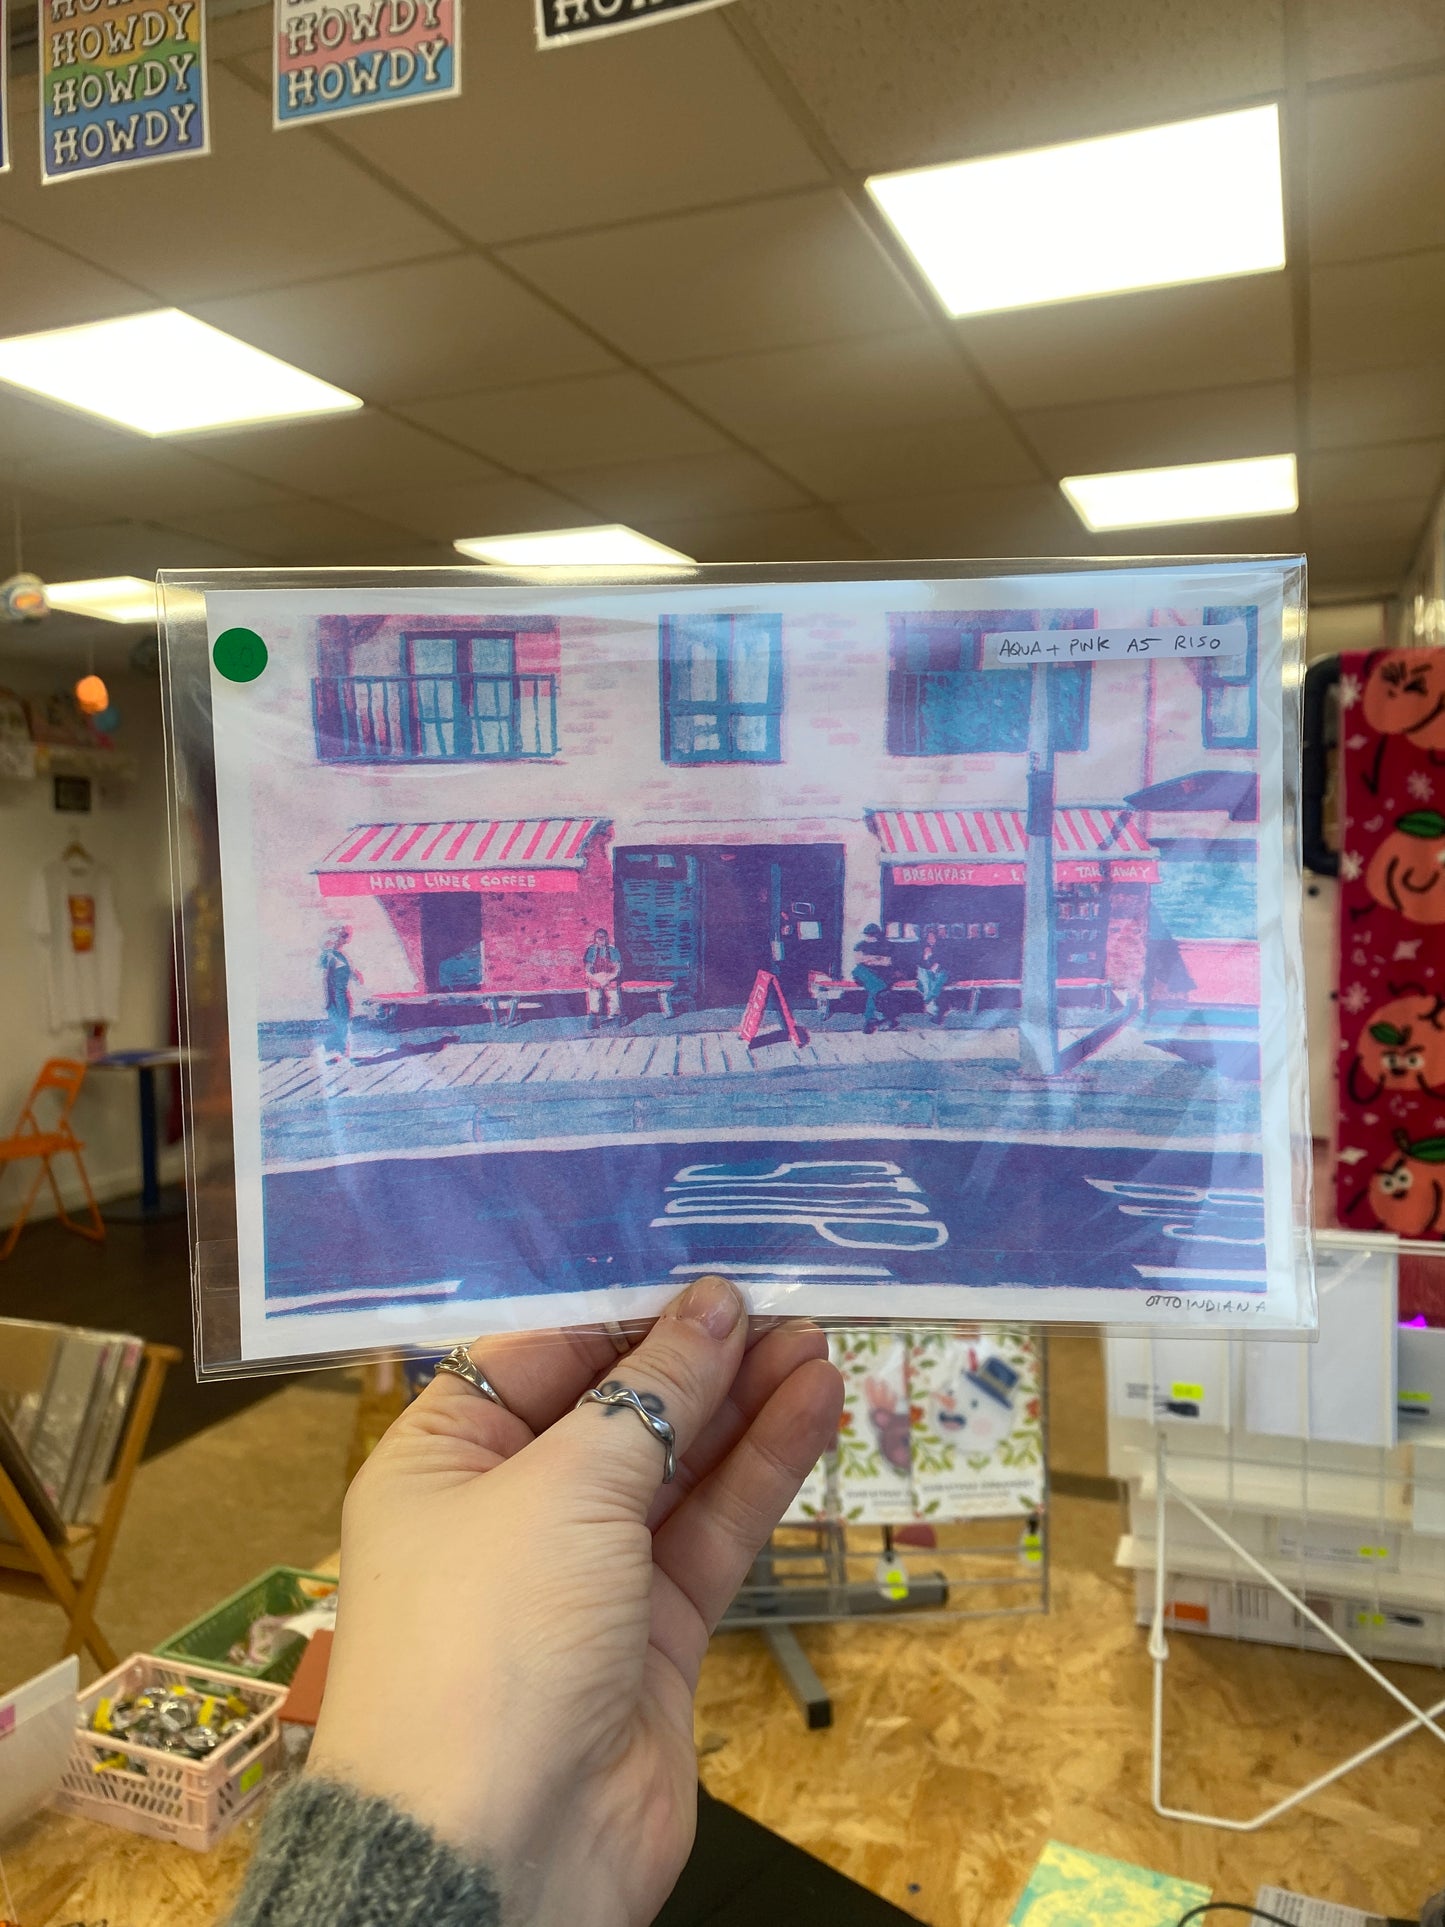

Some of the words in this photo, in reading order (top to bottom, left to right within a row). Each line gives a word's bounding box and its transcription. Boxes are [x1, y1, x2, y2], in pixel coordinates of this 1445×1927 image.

[52, 3, 193, 67] HOWDY
[288, 0, 443, 56] HOWDY
[53, 53, 194, 115] HOWDY
[288, 39, 446, 107] HOWDY
[54, 104, 195, 164] HOWDY
[999, 639, 1042, 657] AQUA
[1126, 637, 1162, 653] A5
[1174, 635, 1221, 650] RISO
[370, 875, 416, 890] HARD
[480, 875, 536, 888] COFFEE
[903, 868, 975, 882] BREAKFAST
[1112, 866, 1150, 878] AWAY
